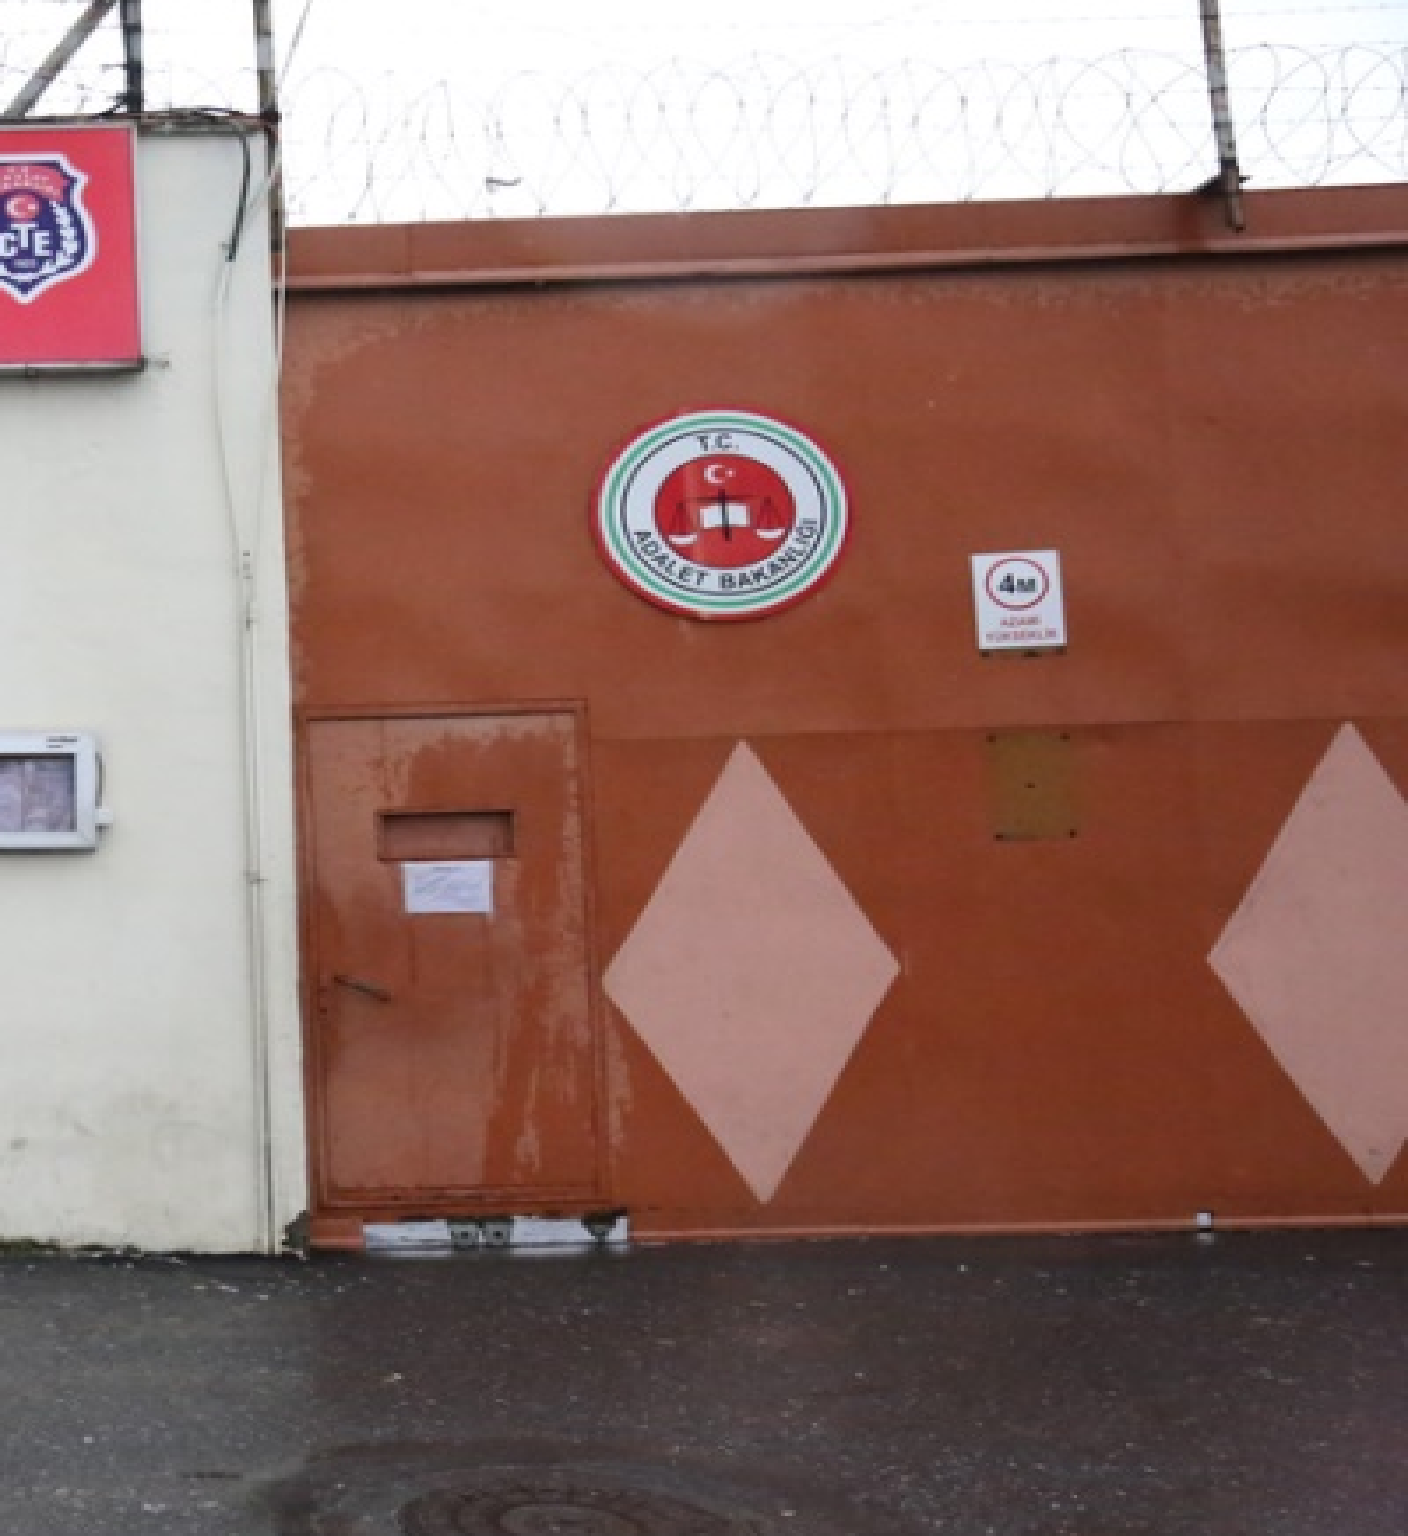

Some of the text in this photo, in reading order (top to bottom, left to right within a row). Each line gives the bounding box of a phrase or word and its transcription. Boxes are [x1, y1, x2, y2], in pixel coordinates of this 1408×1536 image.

[695, 433, 740, 452] T.C.
[633, 517, 819, 590] ADALET BAKANLIĞI
